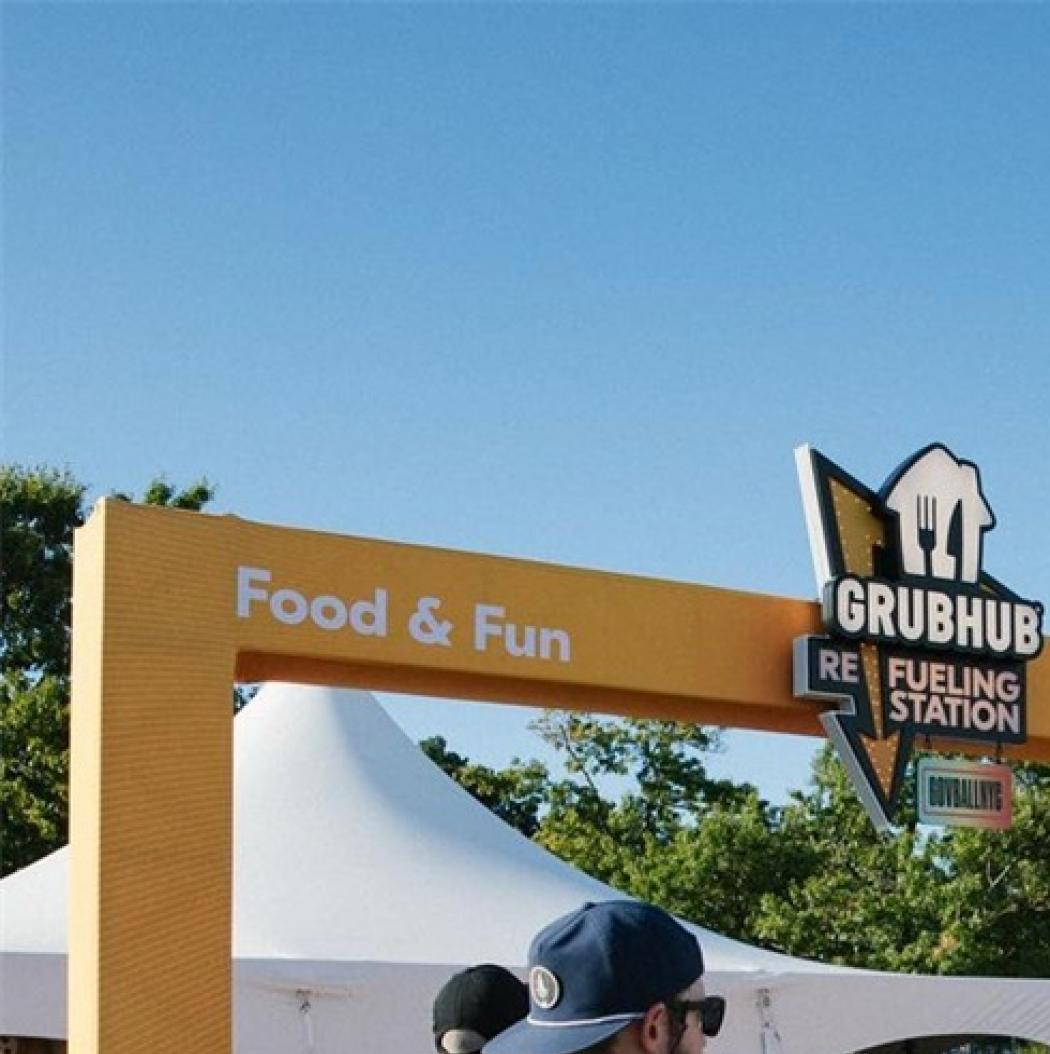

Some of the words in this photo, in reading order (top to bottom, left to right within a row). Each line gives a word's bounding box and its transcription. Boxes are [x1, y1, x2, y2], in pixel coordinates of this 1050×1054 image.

[236, 566, 388, 638] Food
[408, 596, 453, 647] &
[474, 603, 571, 663] Fun
[837, 578, 1041, 655] GRUBHUB
[819, 649, 859, 683] RE
[889, 657, 1021, 702] FUELING
[889, 690, 1020, 733] STATION
